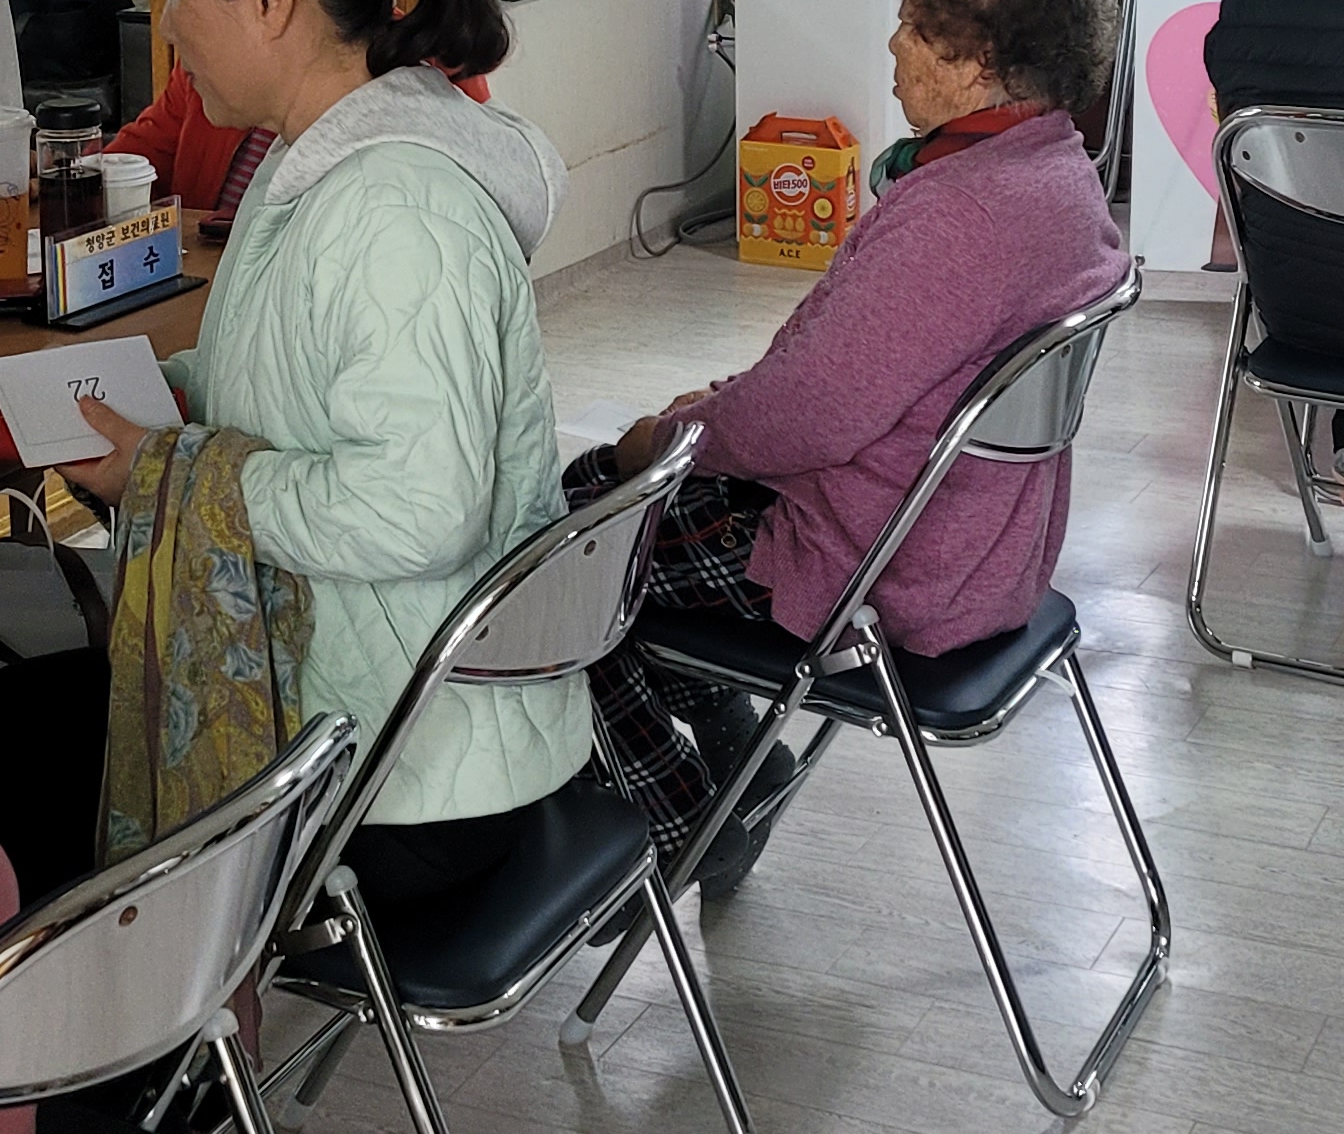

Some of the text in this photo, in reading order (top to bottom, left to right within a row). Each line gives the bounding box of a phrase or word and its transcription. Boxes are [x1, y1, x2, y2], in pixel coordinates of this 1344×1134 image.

[773, 178, 808, 190] 비타500
[85, 211, 170, 254] 청양군 보건의료원
